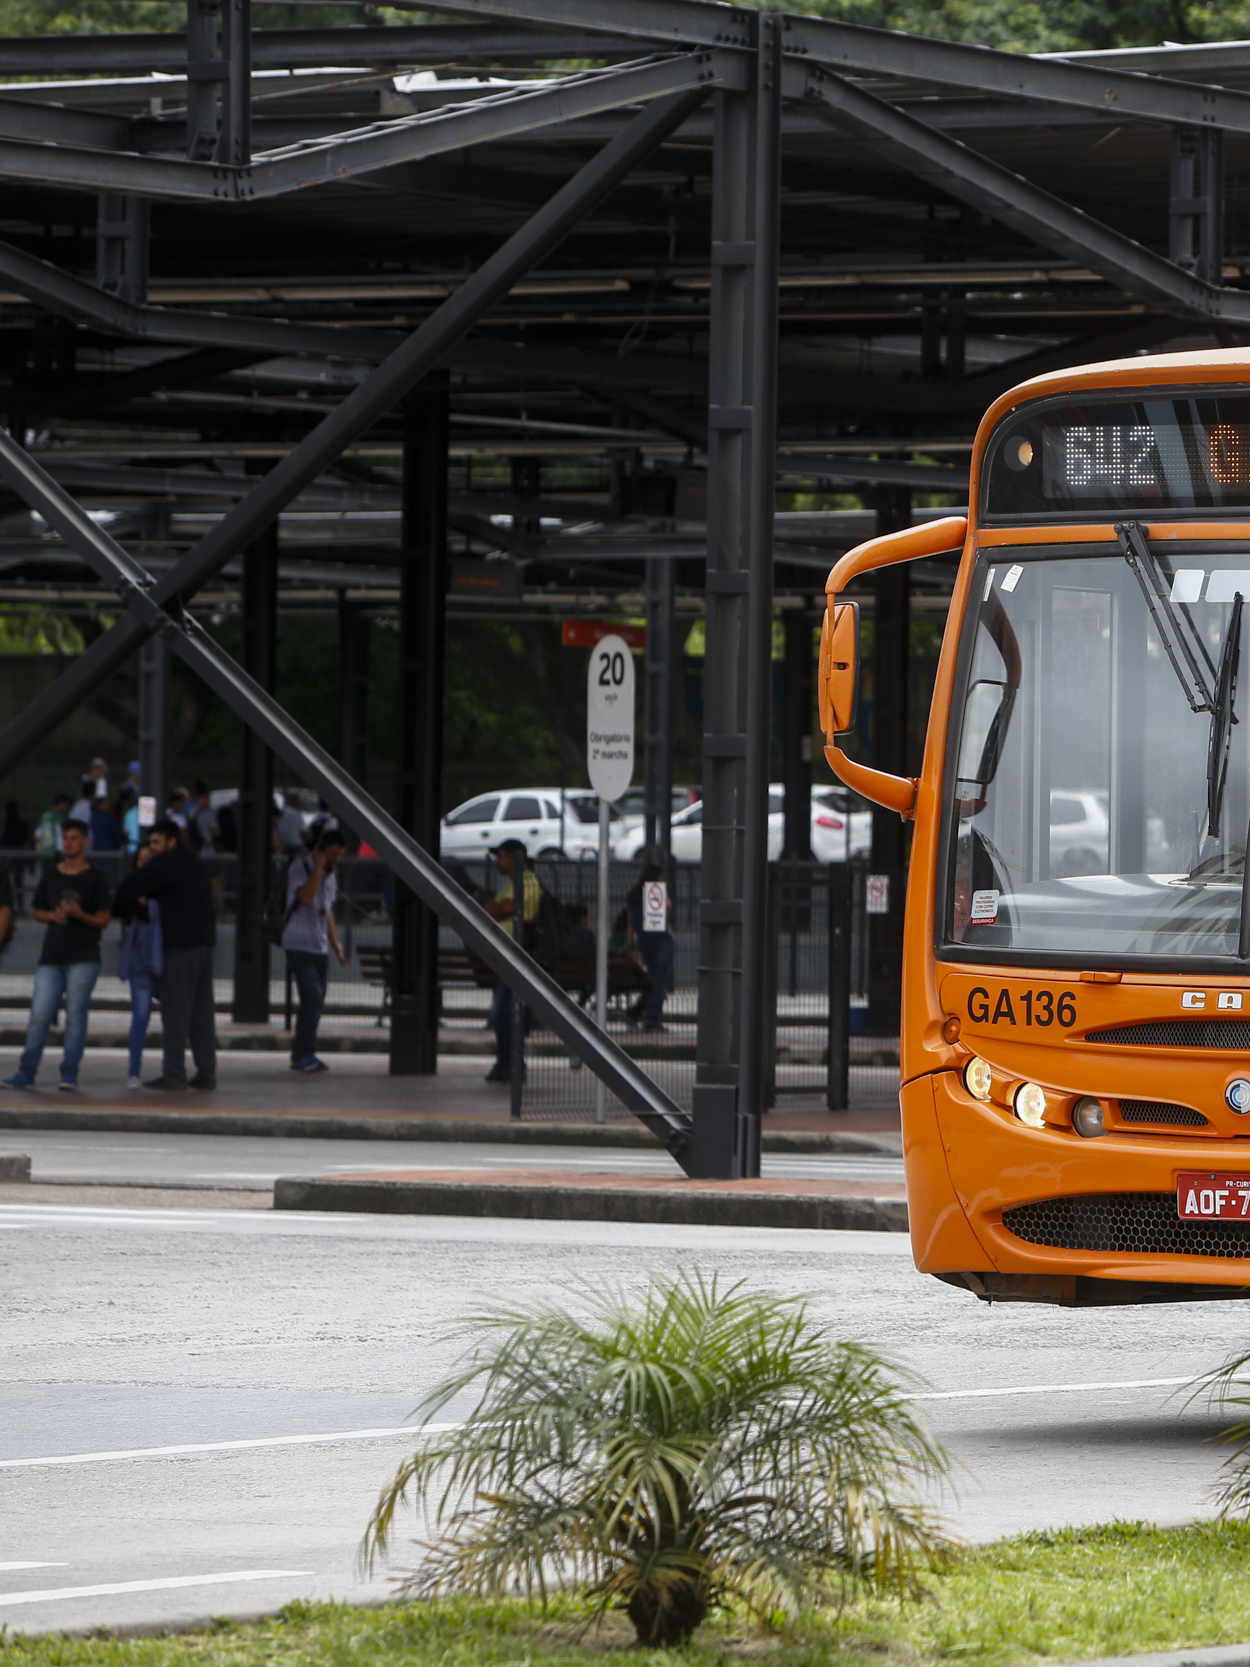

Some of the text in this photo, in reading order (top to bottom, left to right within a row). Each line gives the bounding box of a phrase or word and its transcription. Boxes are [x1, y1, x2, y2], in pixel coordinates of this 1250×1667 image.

[1064, 425, 1155, 486] 642
[598, 651, 625, 686] 20
[601, 750, 628, 760] marcha
[967, 987, 1077, 1028] GA136
